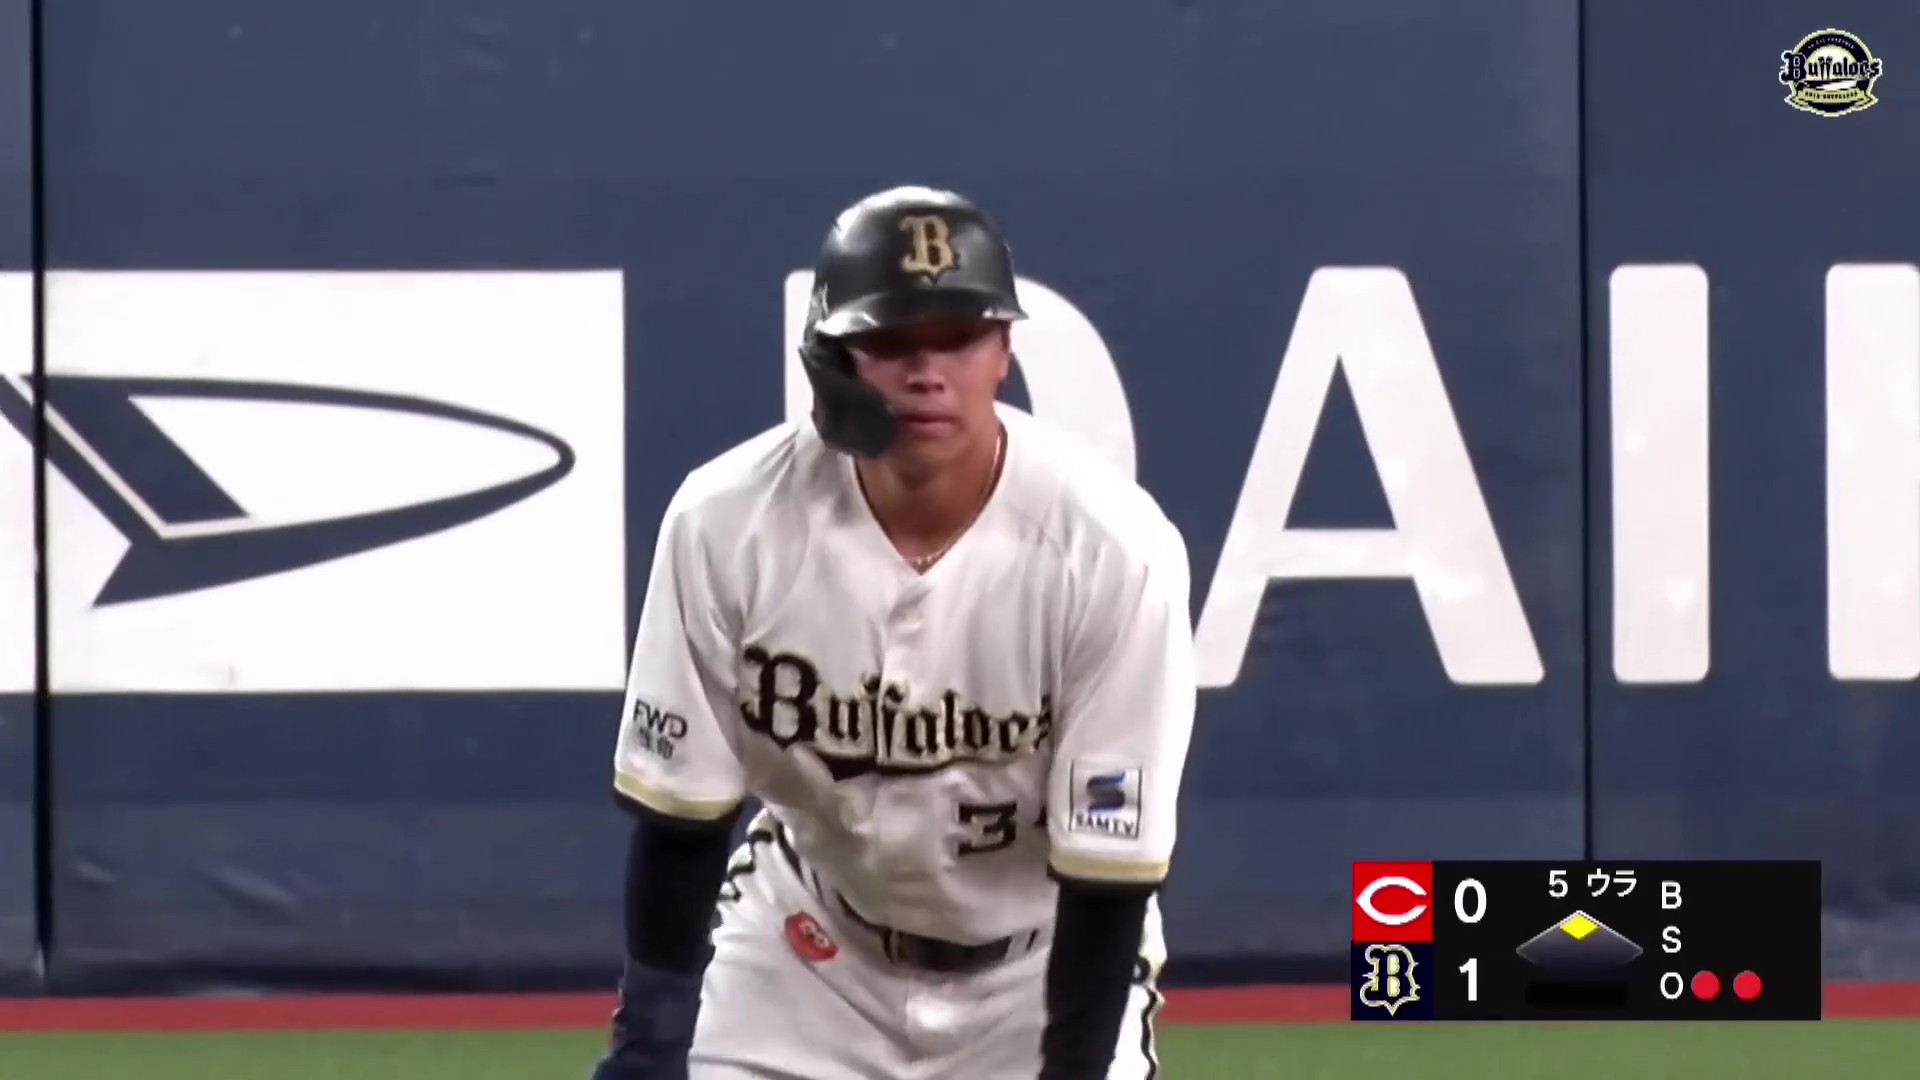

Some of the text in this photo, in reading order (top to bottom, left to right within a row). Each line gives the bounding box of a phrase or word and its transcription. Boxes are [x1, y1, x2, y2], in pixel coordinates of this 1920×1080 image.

[898, 215, 958, 281] B
[785, 263, 1920, 686] AI
[632, 697, 688, 739] FWD
[958, 800, 1048, 857] 3
